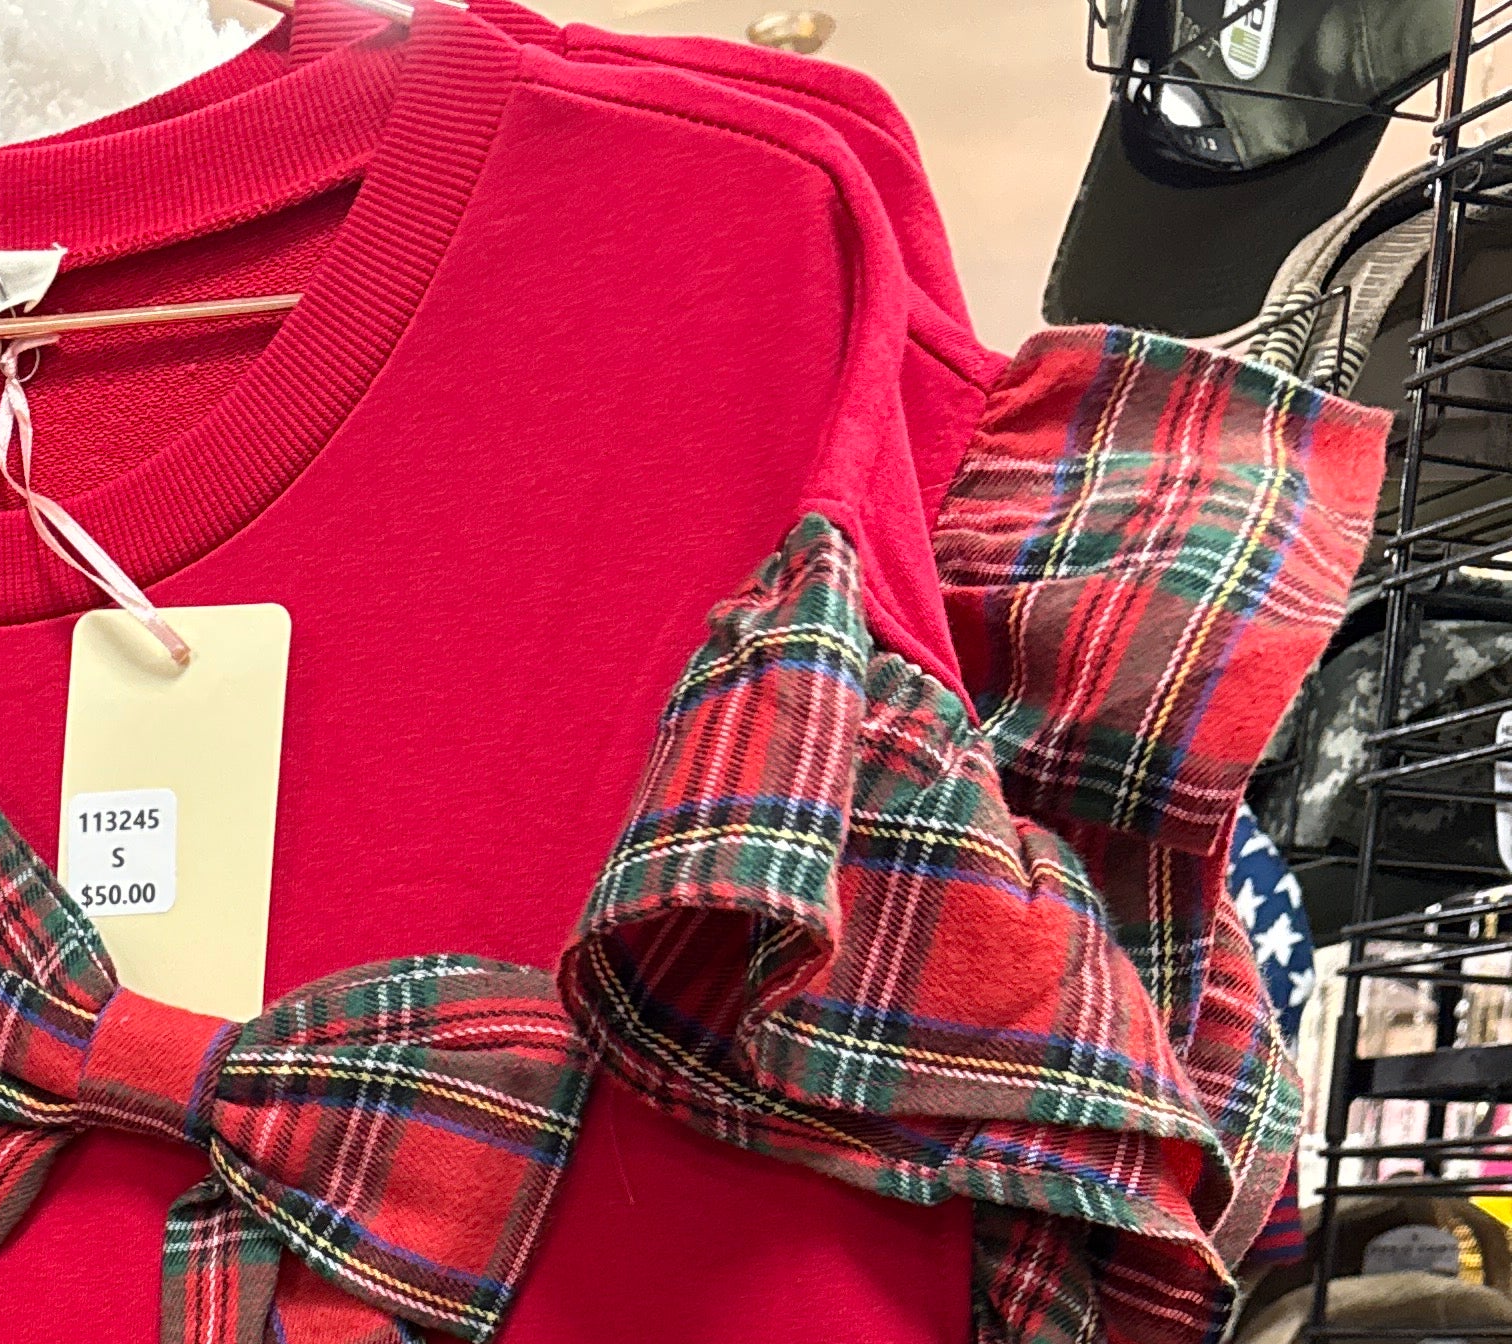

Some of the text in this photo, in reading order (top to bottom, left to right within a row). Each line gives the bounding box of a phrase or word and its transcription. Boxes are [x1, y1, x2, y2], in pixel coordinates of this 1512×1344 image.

[79, 808, 160, 833] 113245
[111, 847, 125, 868] S
[81, 882, 156, 908] $50.00
